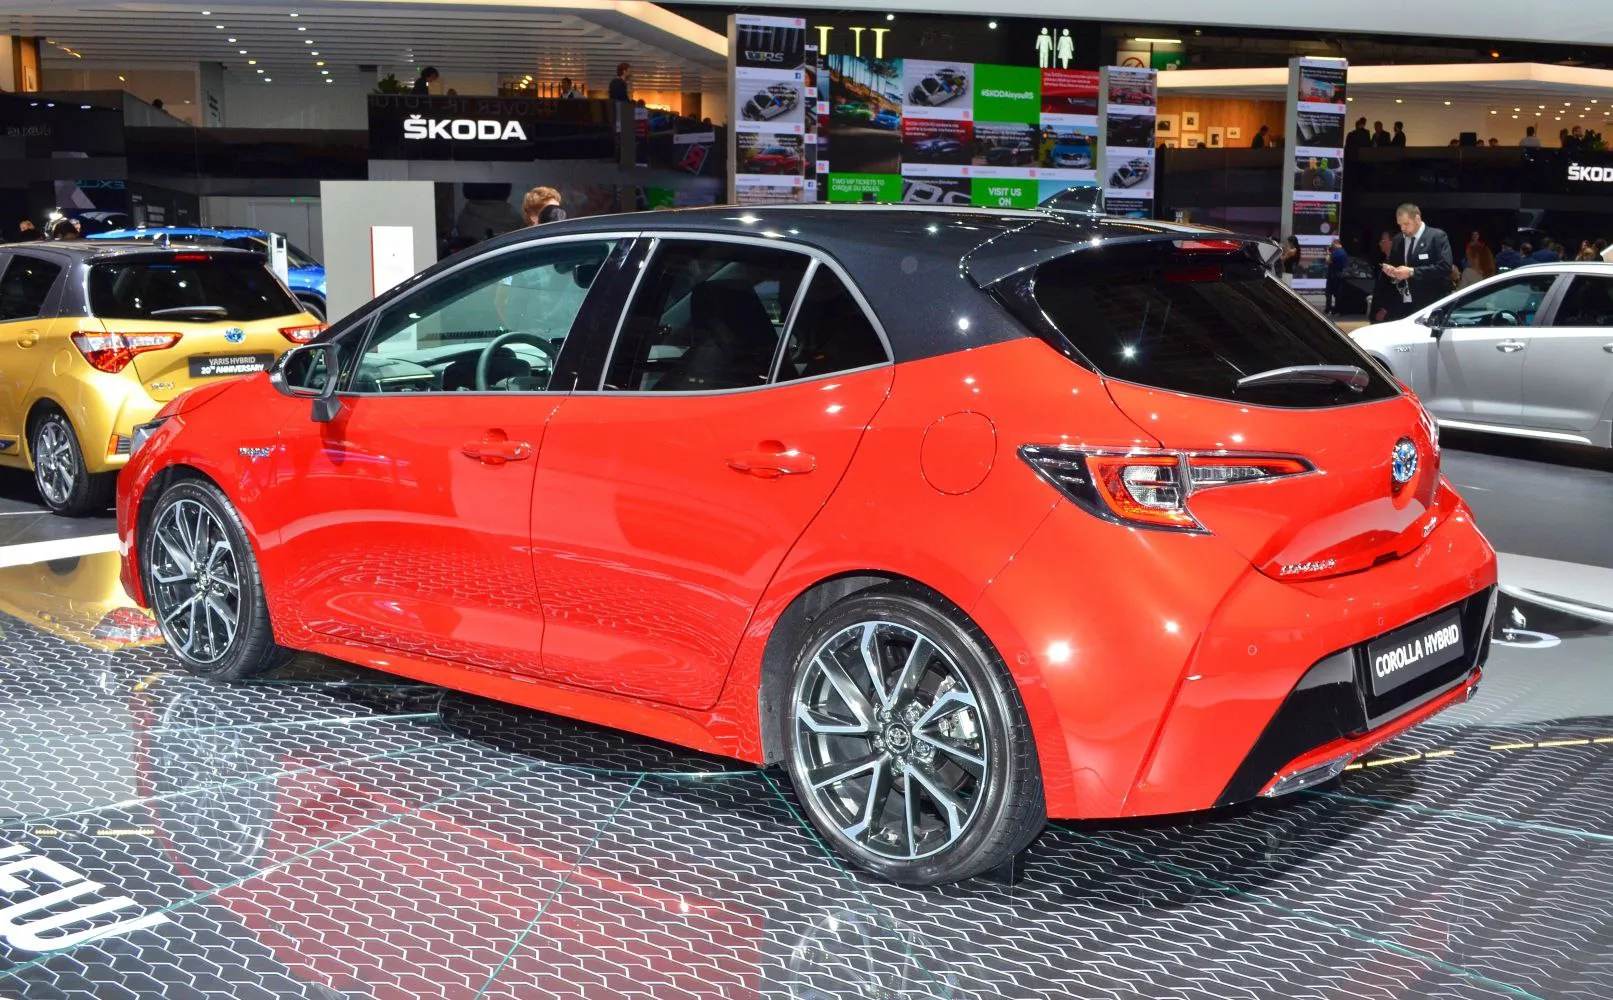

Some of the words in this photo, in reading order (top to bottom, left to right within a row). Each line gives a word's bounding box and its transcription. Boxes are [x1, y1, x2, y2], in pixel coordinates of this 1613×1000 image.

[403, 114, 527, 140] ŠKODA
[832, 184, 852, 192] CIRQUE
[988, 187, 1009, 196] VISIT
[1010, 188, 1022, 196] US
[999, 197, 1011, 206] ON
[209, 357, 230, 366] YARIS
[230, 356, 256, 365] HYBRID
[216, 363, 265, 374] ANNIVERSARY
[1376, 639, 1423, 678] COROLLA
[1424, 624, 1459, 656] HYBRID
